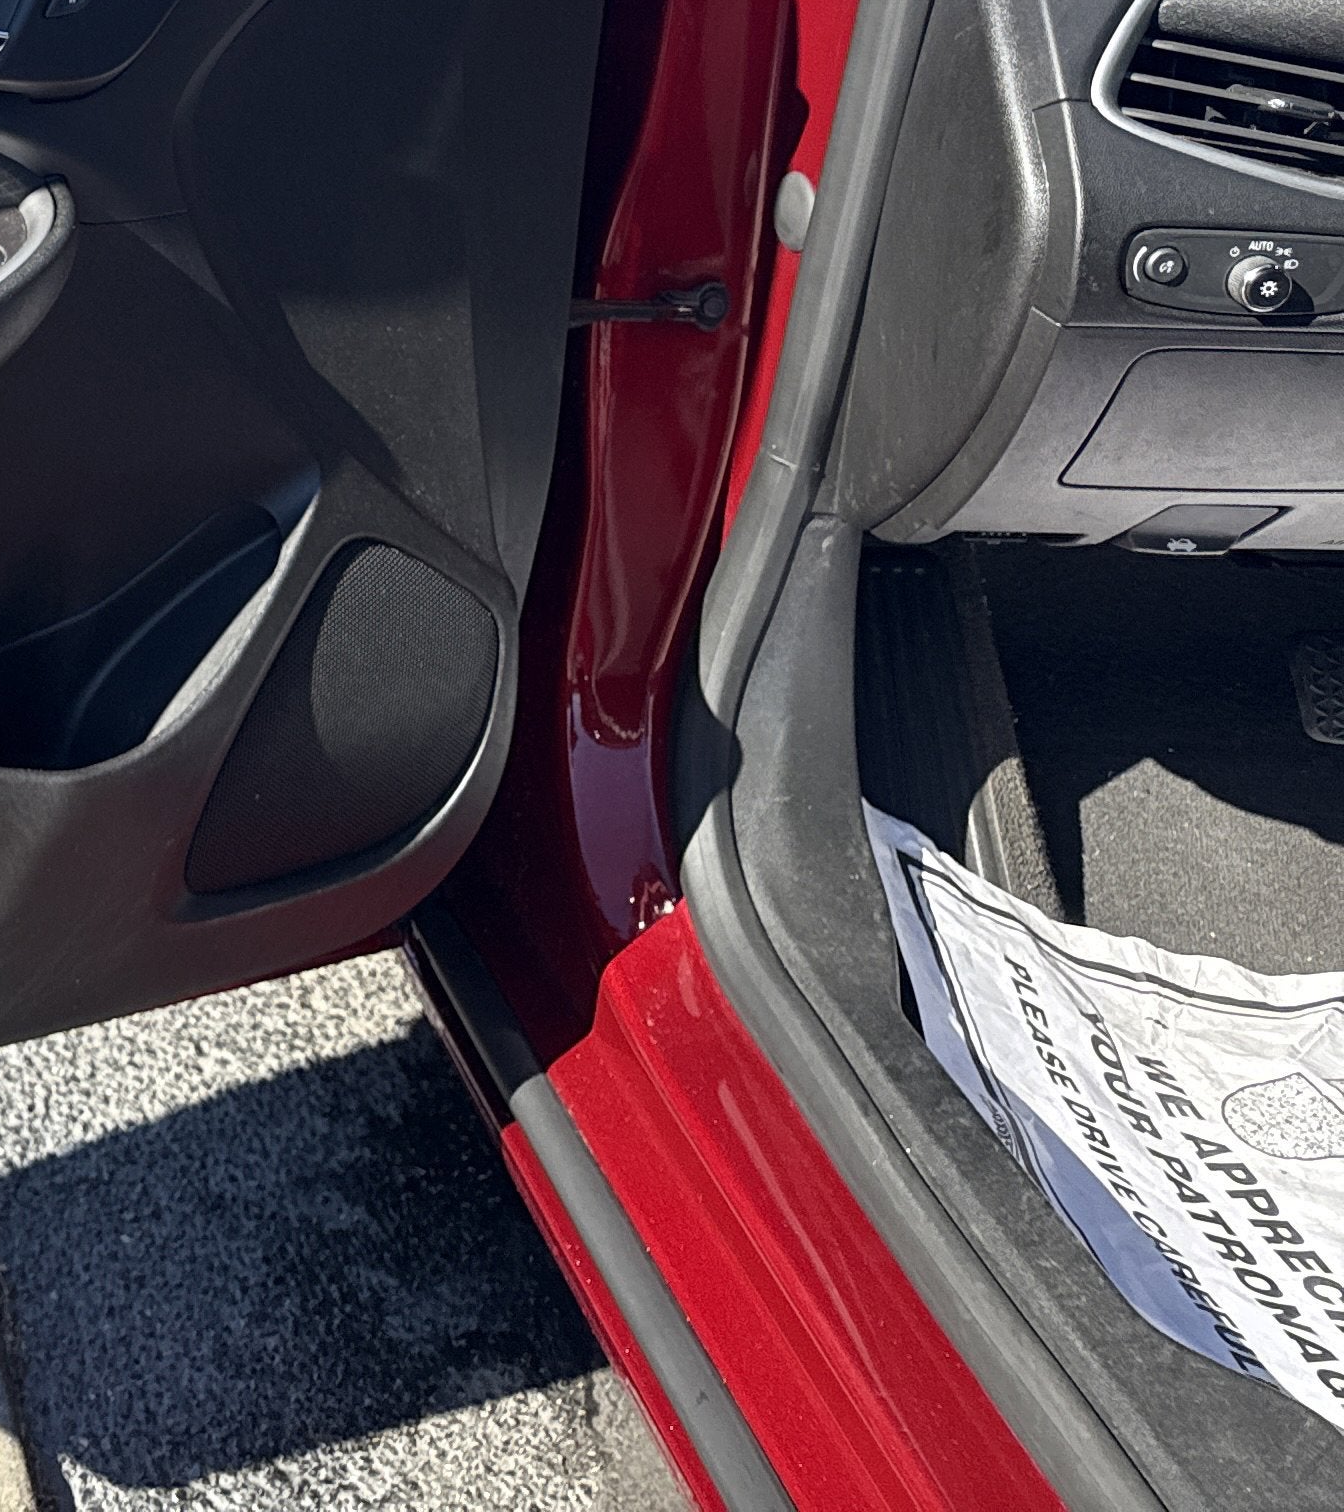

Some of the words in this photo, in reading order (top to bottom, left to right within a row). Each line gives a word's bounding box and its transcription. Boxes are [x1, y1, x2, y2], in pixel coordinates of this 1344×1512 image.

[1247, 240, 1274, 252] AUTO
[1003, 953, 1081, 1095] PLEASE
[1060, 1094, 1149, 1208] DRIVE
[1132, 1210, 1280, 1390] CAREFUL
[1134, 1054, 1206, 1121] WE
[1079, 1008, 1163, 1141] YOUR
[1146, 1145, 1344, 1409] PATRONAG
